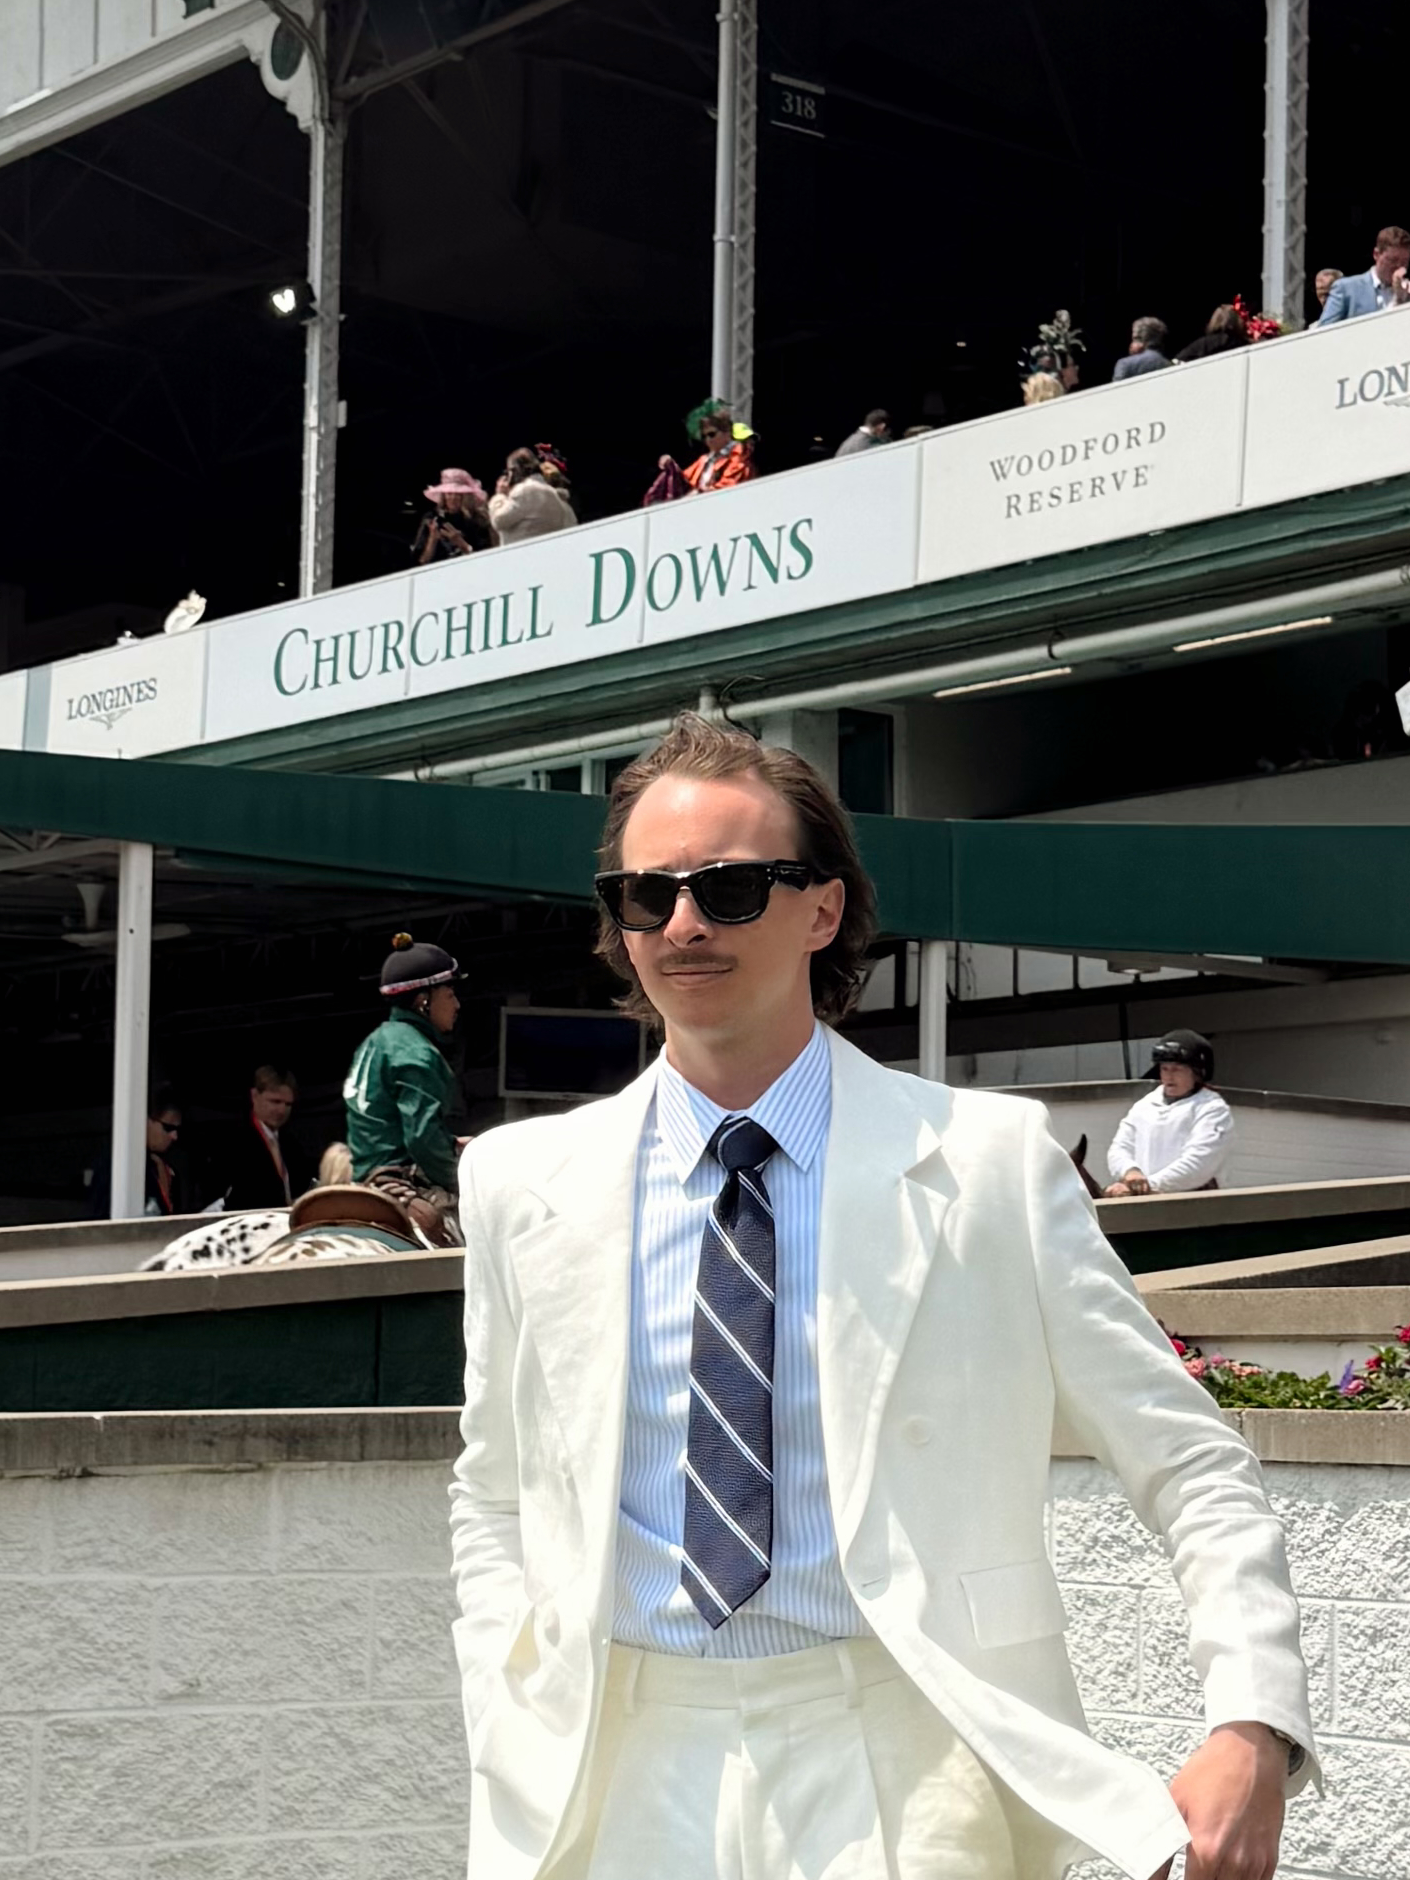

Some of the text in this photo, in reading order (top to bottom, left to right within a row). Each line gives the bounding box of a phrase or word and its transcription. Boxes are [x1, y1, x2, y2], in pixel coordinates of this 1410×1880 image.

[781, 90, 817, 120] 318
[989, 421, 1168, 484] WOODFORD
[1003, 464, 1150, 519] RESERVE
[272, 517, 814, 697] CHURCHILL DOWNS
[66, 677, 159, 721] LONGINES
